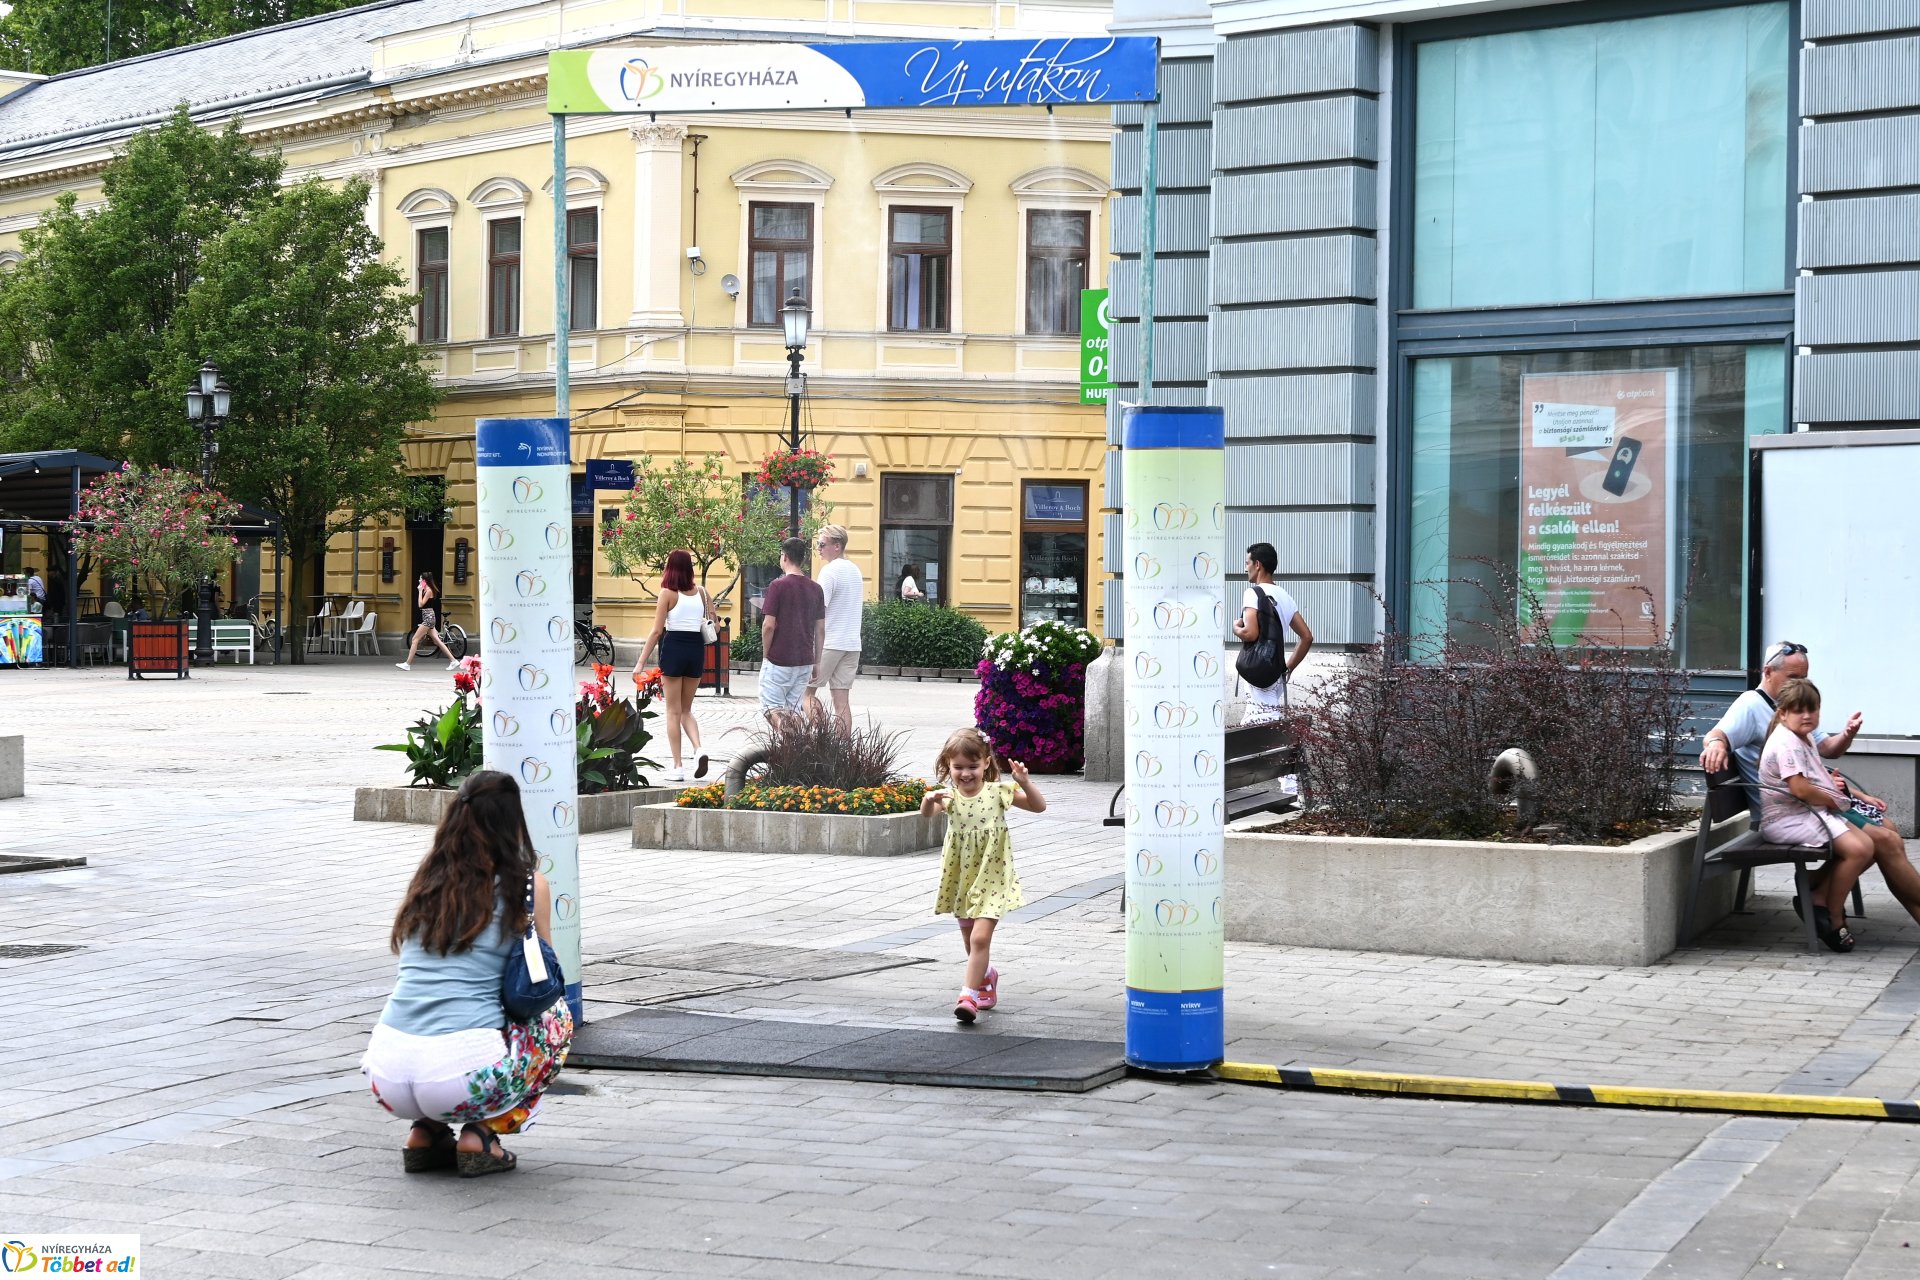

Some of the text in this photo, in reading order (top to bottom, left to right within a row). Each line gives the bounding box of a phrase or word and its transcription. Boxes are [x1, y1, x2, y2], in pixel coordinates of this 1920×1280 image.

[670, 66, 799, 88] NYÍREGYHÁZA
[904, 37, 1116, 106] Új utakon
[1626, 389, 1655, 399] otpbank
[1543, 426, 1573, 434] biztonsági
[1573, 425, 1609, 433] számlánkra!
[1528, 484, 1570, 501] Legyél
[1034, 503, 1058, 511] Villeroy
[1528, 502, 1592, 516] felkészült
[1528, 520, 1620, 535] a csalók ellen!
[1528, 540, 1648, 552] Mindig gyanakodj és figyelmeztesd
[1580, 553, 1609, 561] azonnal
[1528, 566, 1543, 574] meg
[1573, 564, 1582, 572] ha
[1599, 563, 1625, 572] kérnek,
[1528, 575, 1544, 585] hogy
[1545, 575, 1562, 585] utalj
